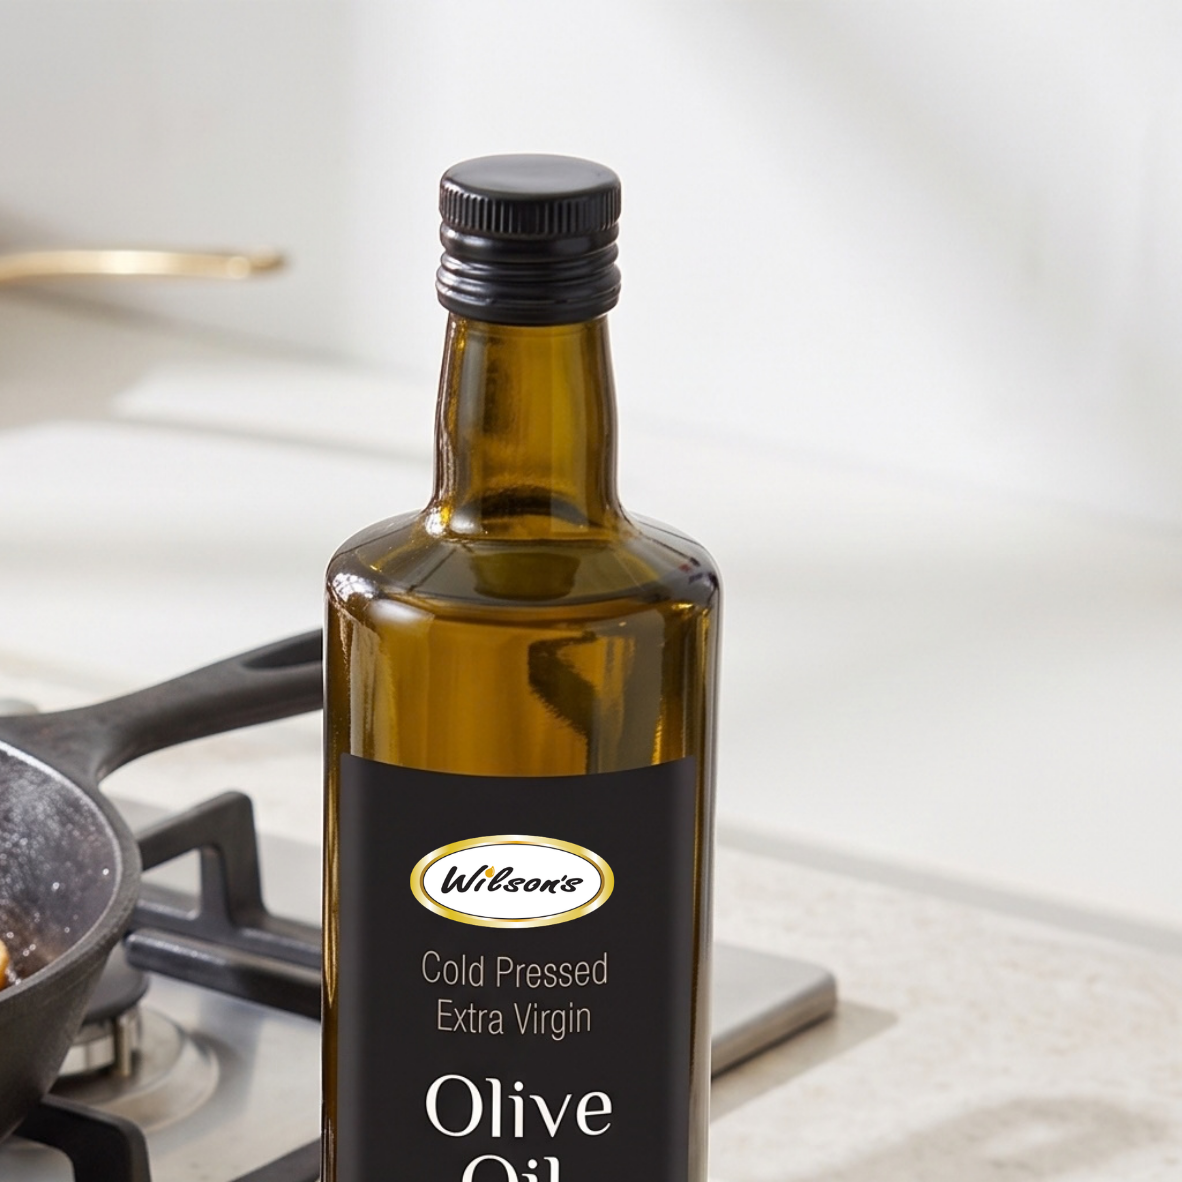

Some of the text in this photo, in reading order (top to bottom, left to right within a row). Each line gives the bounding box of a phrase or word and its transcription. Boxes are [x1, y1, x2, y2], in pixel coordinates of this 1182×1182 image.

[441, 864, 584, 894] Wilson's
[422, 950, 608, 989] Cold Pressed
[437, 998, 591, 1041] Extra Virgin
[425, 1074, 613, 1138] Olive
